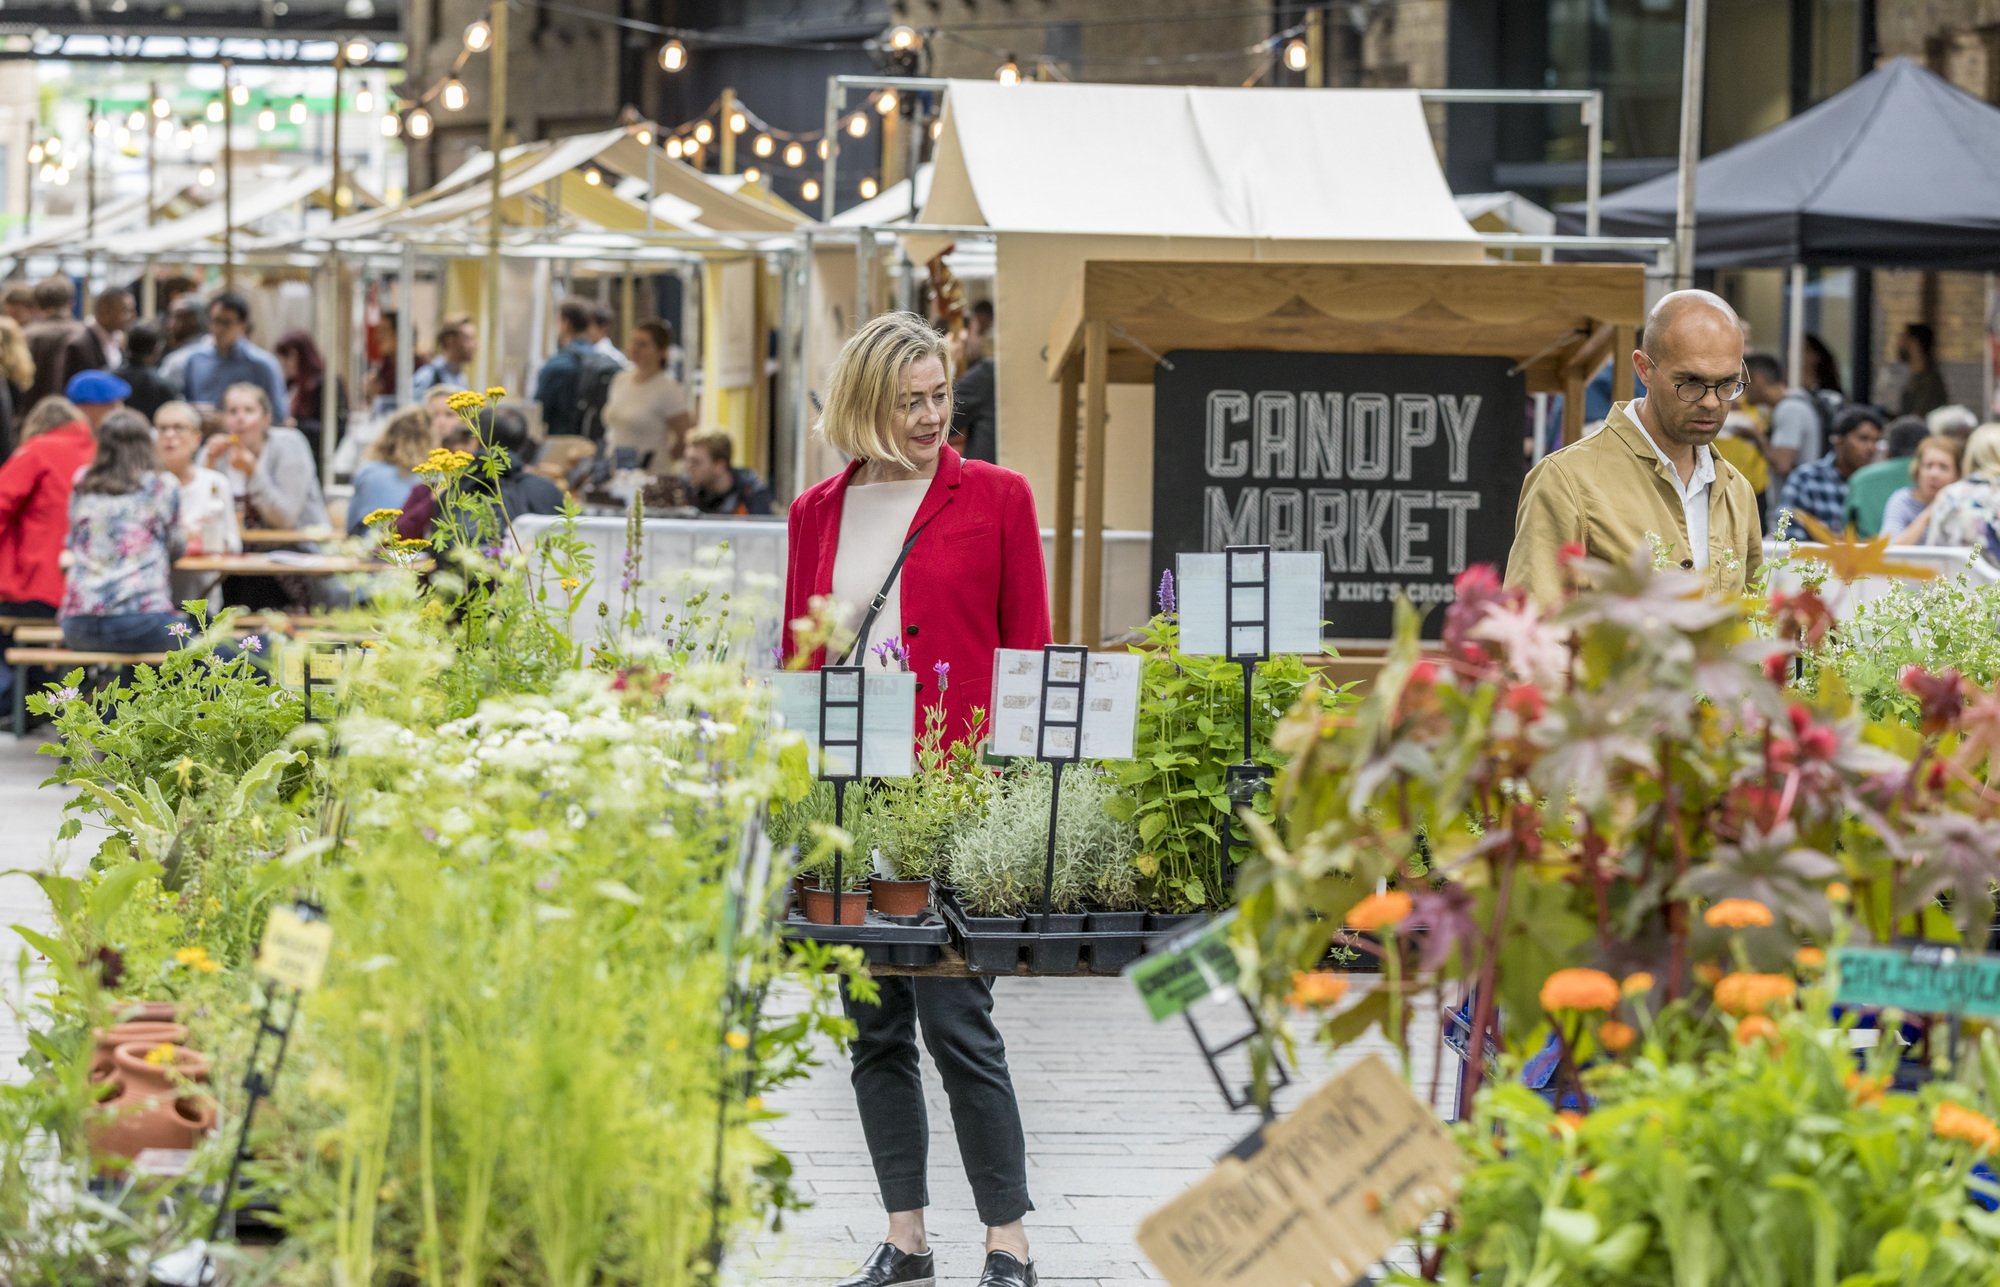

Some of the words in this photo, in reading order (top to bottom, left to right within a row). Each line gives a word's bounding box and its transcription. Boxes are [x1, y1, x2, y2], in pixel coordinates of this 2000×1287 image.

[1205, 389, 1482, 482] CANOPY
[1203, 486, 1480, 574] MARKET
[1337, 581, 1402, 602] KING'S
[1405, 582, 1458, 602] CROS
